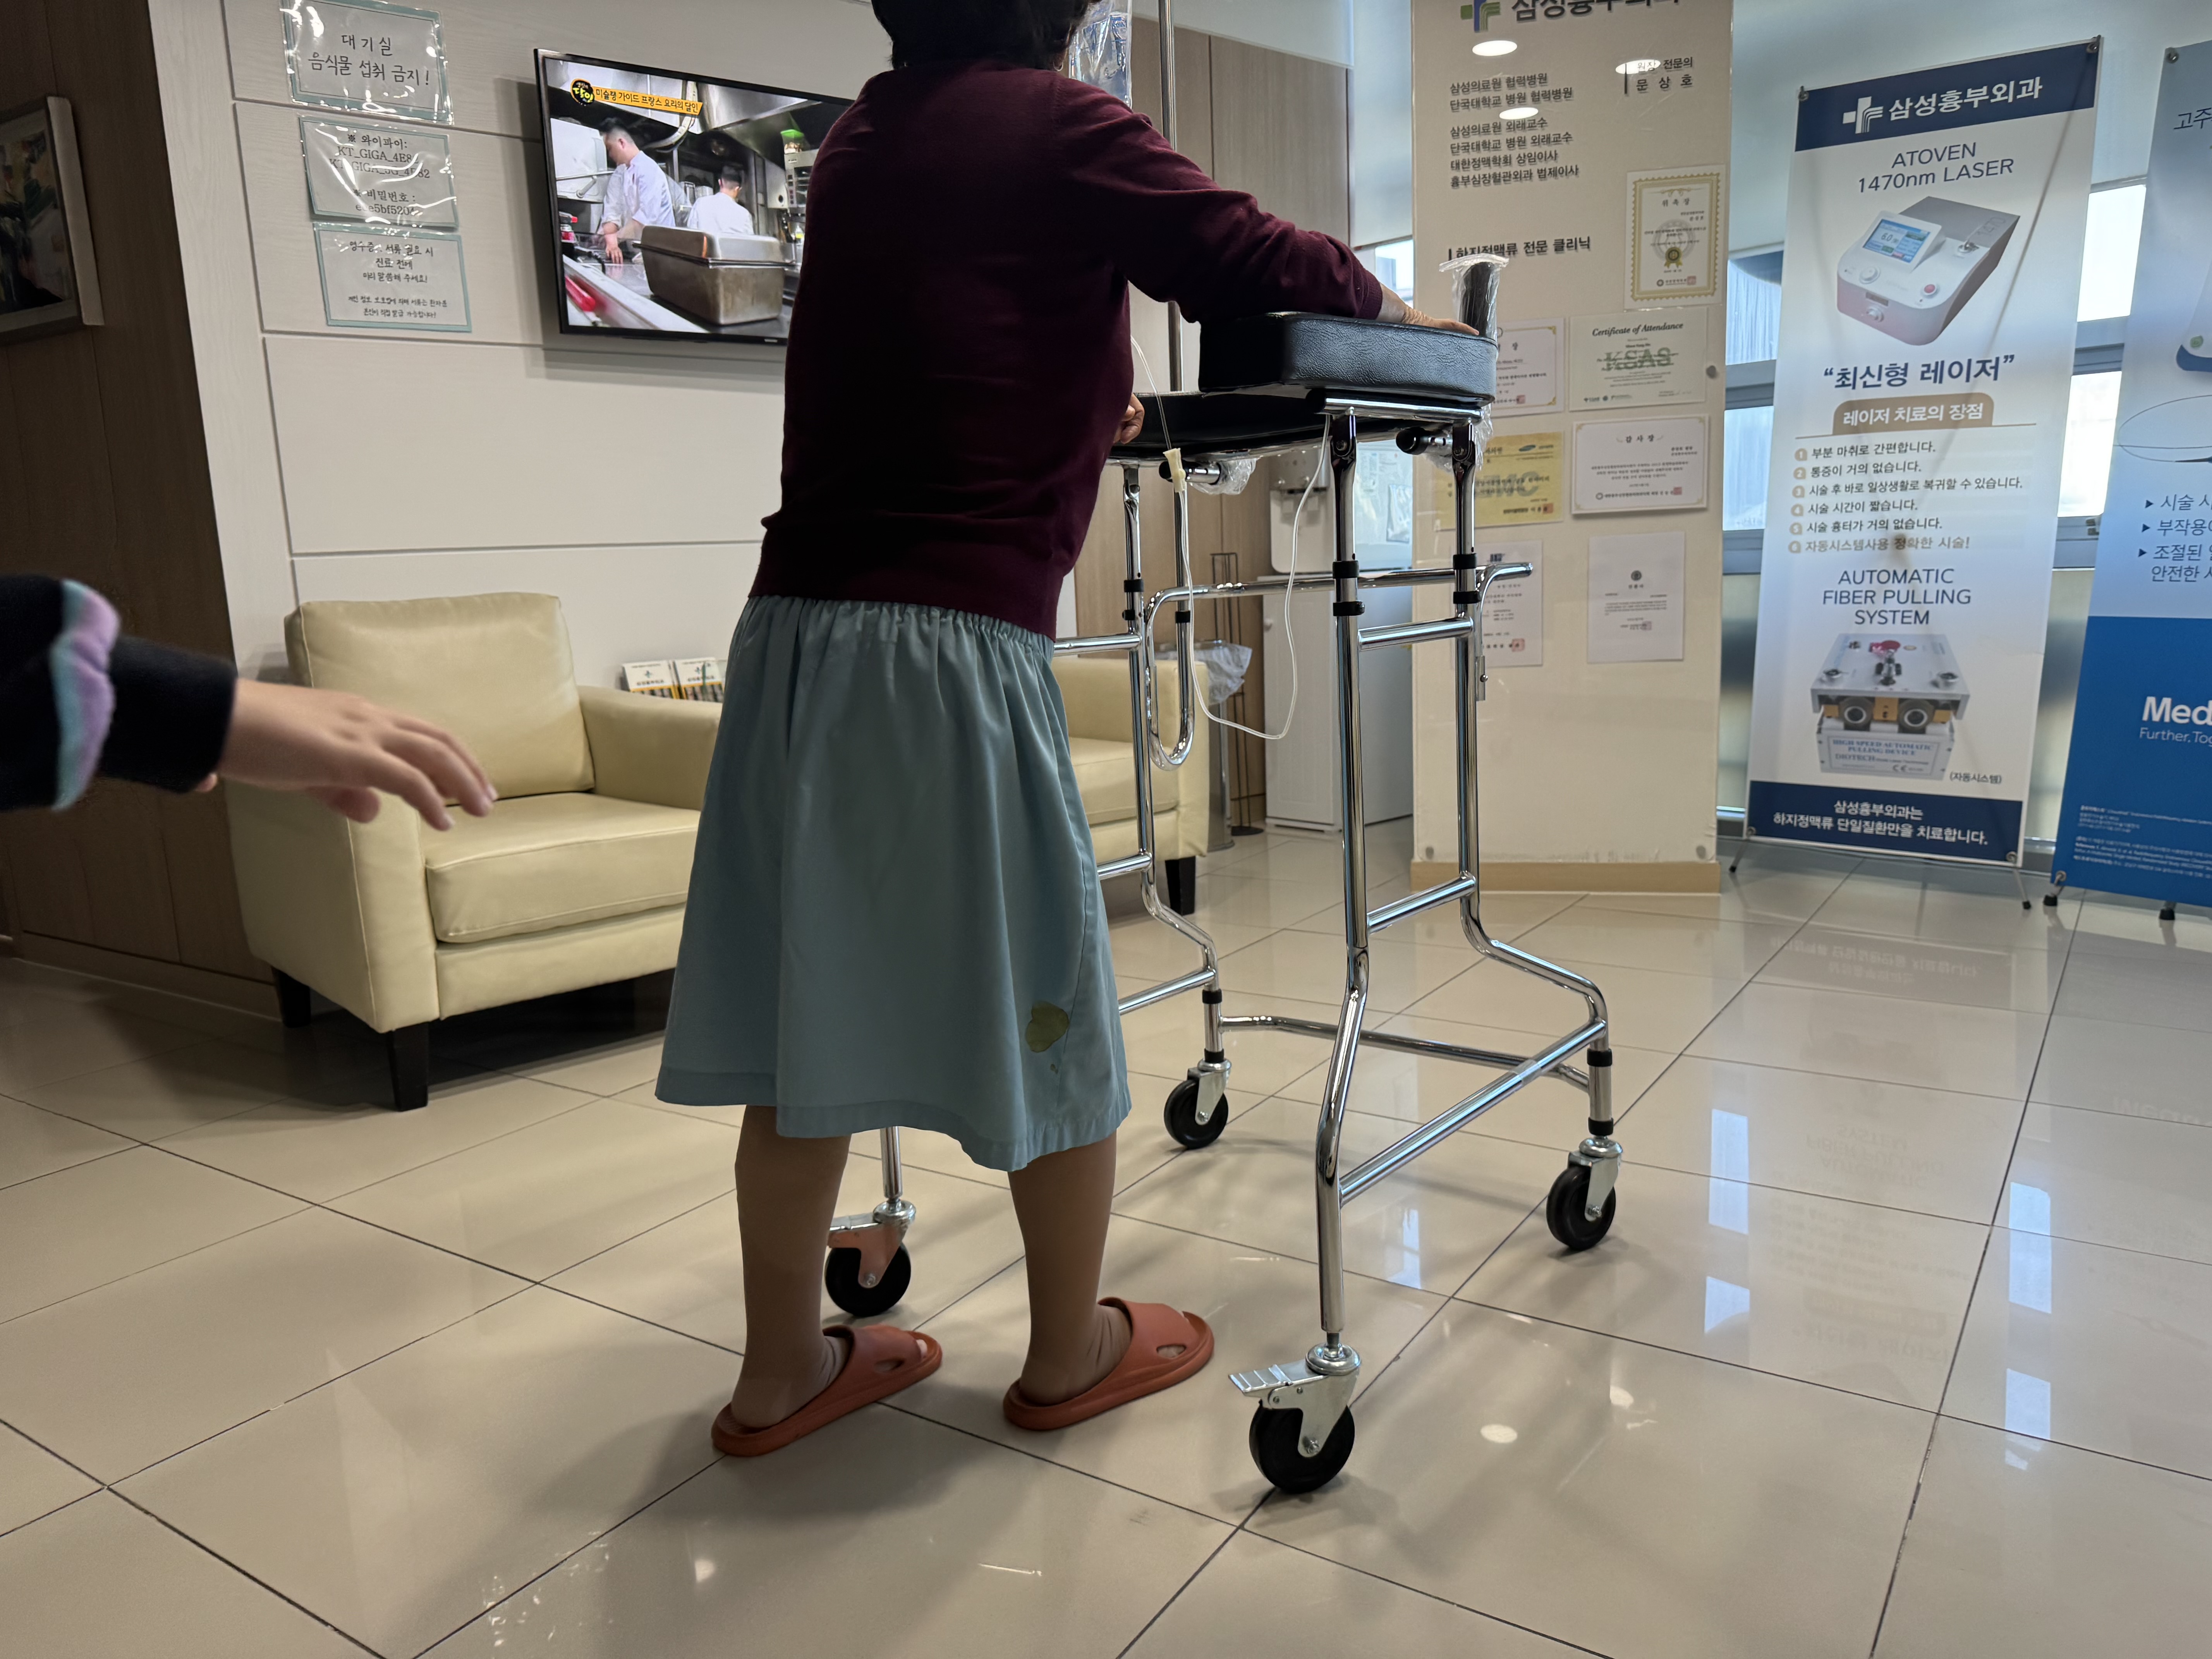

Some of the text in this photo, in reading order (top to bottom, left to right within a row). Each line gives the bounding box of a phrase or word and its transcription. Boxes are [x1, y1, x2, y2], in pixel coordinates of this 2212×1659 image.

[1512, 0, 1679, 22] 삼성흉
[308, 52, 352, 76] 음식물
[359, 60, 385, 80] 섭취
[1663, 57, 1693, 69] 전문의
[1450, 73, 1548, 93] 삼성의료원 협력병원
[596, 89, 698, 113] 미슐랭 가이드 프랑스 요리의 달인
[1450, 87, 1573, 111] 단국대학교 병원 협력병원
[1889, 77, 2043, 121] 삼성흉부외과
[1450, 117, 1548, 137] 삼성의료원 외래교수
[2173, 107, 2212, 130] 고주
[361, 135, 407, 150] 와이파이:
[1450, 132, 1573, 154] 단국대학교 병원 외래교수
[1450, 150, 1558, 170] 대한정맥학회 상임이사
[1891, 142, 1977, 168] ATOVEN
[1451, 165, 1579, 188] 흉부심장혈관외과 법제이사
[1858, 158, 2014, 193] 1470nm LASER
[355, 204, 417, 216] ee5bf520
[386, 244, 402, 254] 서류
[425, 247, 433, 257] 시
[1523, 240, 1548, 254] 전문
[1553, 236, 1590, 252] 클리닉
[375, 258, 413, 270] 진료 전에
[363, 272, 376, 280] 미리
[378, 272, 401, 282] 말씀해
[1592, 322, 1683, 337] Certificate of Attendance
[1843, 402, 1984, 426] 레이저 치료의 장점
[1812, 447, 1834, 459] 부분
[1837, 445, 1870, 457] 마취로
[1874, 441, 1936, 455] 간편합니다.
[1810, 465, 1842, 478] 통증이
[1846, 463, 1868, 475] 거의
[1872, 461, 1922, 475] 없습니다.
[1809, 484, 1829, 496] 시술
[1831, 484, 1841, 495] 후
[1844, 483, 1865, 495] 바로
[1867, 480, 1920, 493] 일상생활로
[1923, 478, 1957, 491] 복귀할
[1960, 478, 1972, 489] 수
[1975, 476, 2023, 490] 있습니다.
[1807, 503, 1829, 515] 시술
[1832, 501, 1865, 514] 시간이
[1869, 499, 1918, 512] 짧습니다.
[2160, 494, 2194, 511] 시술
[1807, 521, 1827, 534] 시술
[1831, 520, 1863, 532] 흉터가
[1867, 519, 1889, 531] 거의
[1893, 517, 1942, 530] 없습니다.
[1805, 538, 1889, 552] 자동시스템사용
[1894, 536, 1933, 551] 정확한
[1938, 535, 1970, 550] 시술!
[2153, 544, 2202, 561] 조절된
[1838, 568, 1955, 585] AUTOMATIC
[2151, 565, 2200, 582] 안전한
[1823, 589, 1972, 605] FIBER PULLING
[1854, 610, 1930, 625] SYSTEM
[1949, 771, 2002, 785] (자동시스템)
[1834, 800, 1923, 821] 삼성흉부외과는
[1773, 812, 1989, 845] 하지정맥류 단일질환만을 치료합니다.
